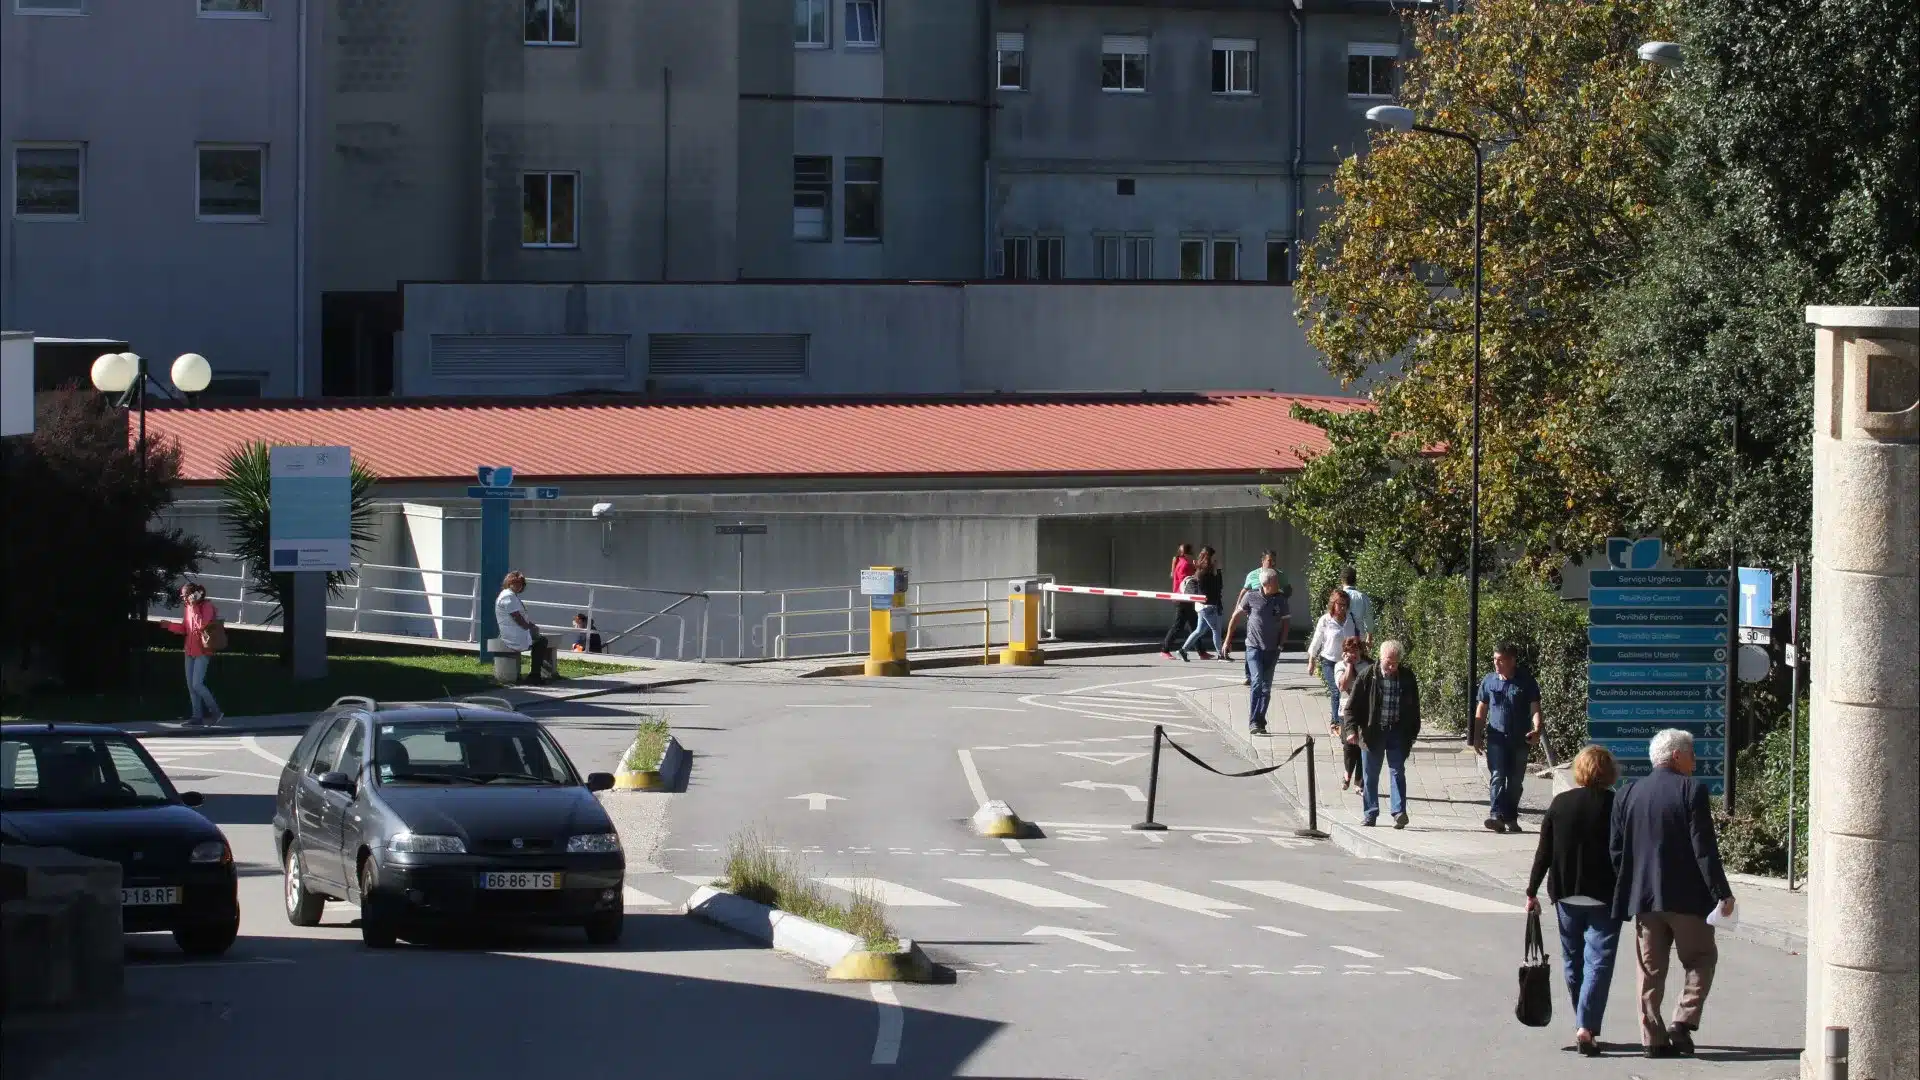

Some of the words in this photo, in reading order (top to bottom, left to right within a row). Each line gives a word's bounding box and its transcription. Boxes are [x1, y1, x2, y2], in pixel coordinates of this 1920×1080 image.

[1618, 575, 1646, 585] Serviço
[1648, 575, 1682, 585] Urgência
[1615, 612, 1648, 620] Pavilhão
[1650, 612, 1684, 620] Feminino
[1746, 631, 1758, 641] 50
[1595, 688, 1628, 696] Pavilhão
[1616, 726, 1649, 734] Pavilhão
[1055, 828, 1317, 850] STOP
[487, 874, 552, 888] 66-86-TS
